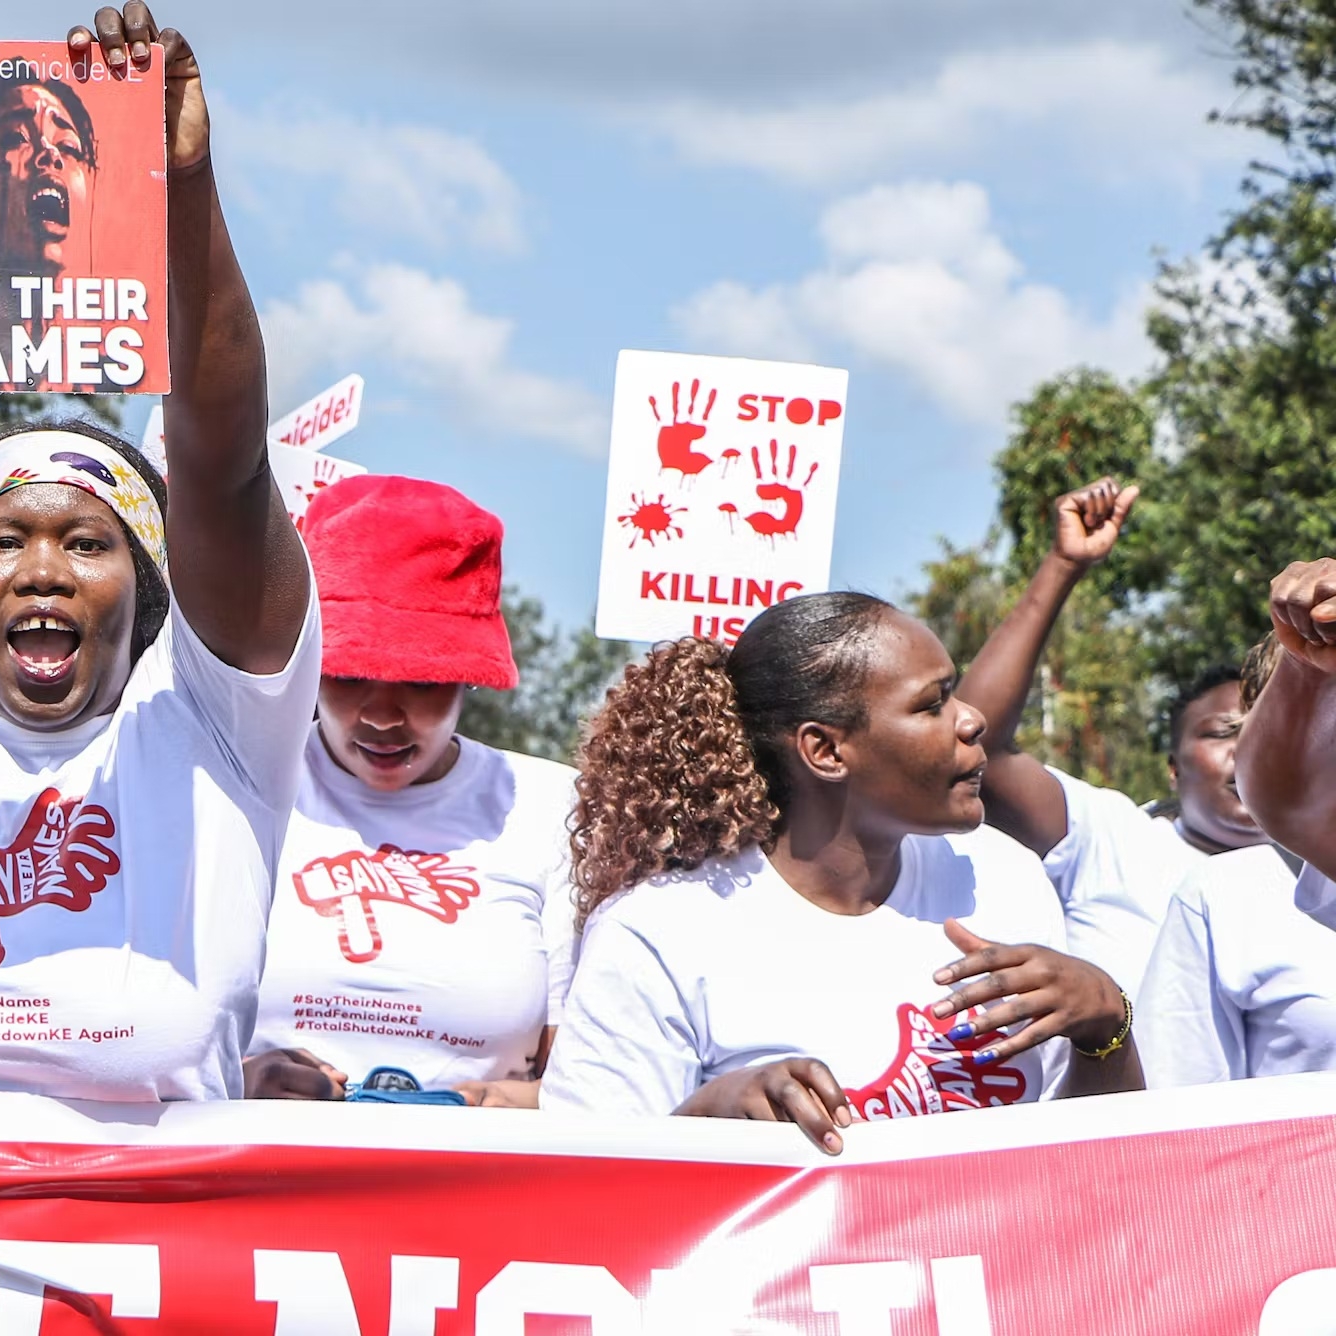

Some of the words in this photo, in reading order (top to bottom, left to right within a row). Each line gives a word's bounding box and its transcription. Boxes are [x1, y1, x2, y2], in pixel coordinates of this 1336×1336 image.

[11, 276, 149, 321] THEIR
[280, 384, 355, 446] icide!
[736, 394, 842, 426] STOP
[692, 614, 745, 648] US
[331, 857, 384, 894] SAY
[293, 995, 423, 1012] #SayTheirNames
[294, 1008, 419, 1025] #EndFemicideKE
[79, 1025, 135, 1043] Again!
[295, 1021, 435, 1040] #TotalShutdownKE
[439, 1032, 486, 1048] Again!
[864, 1066, 922, 1121] SAY
